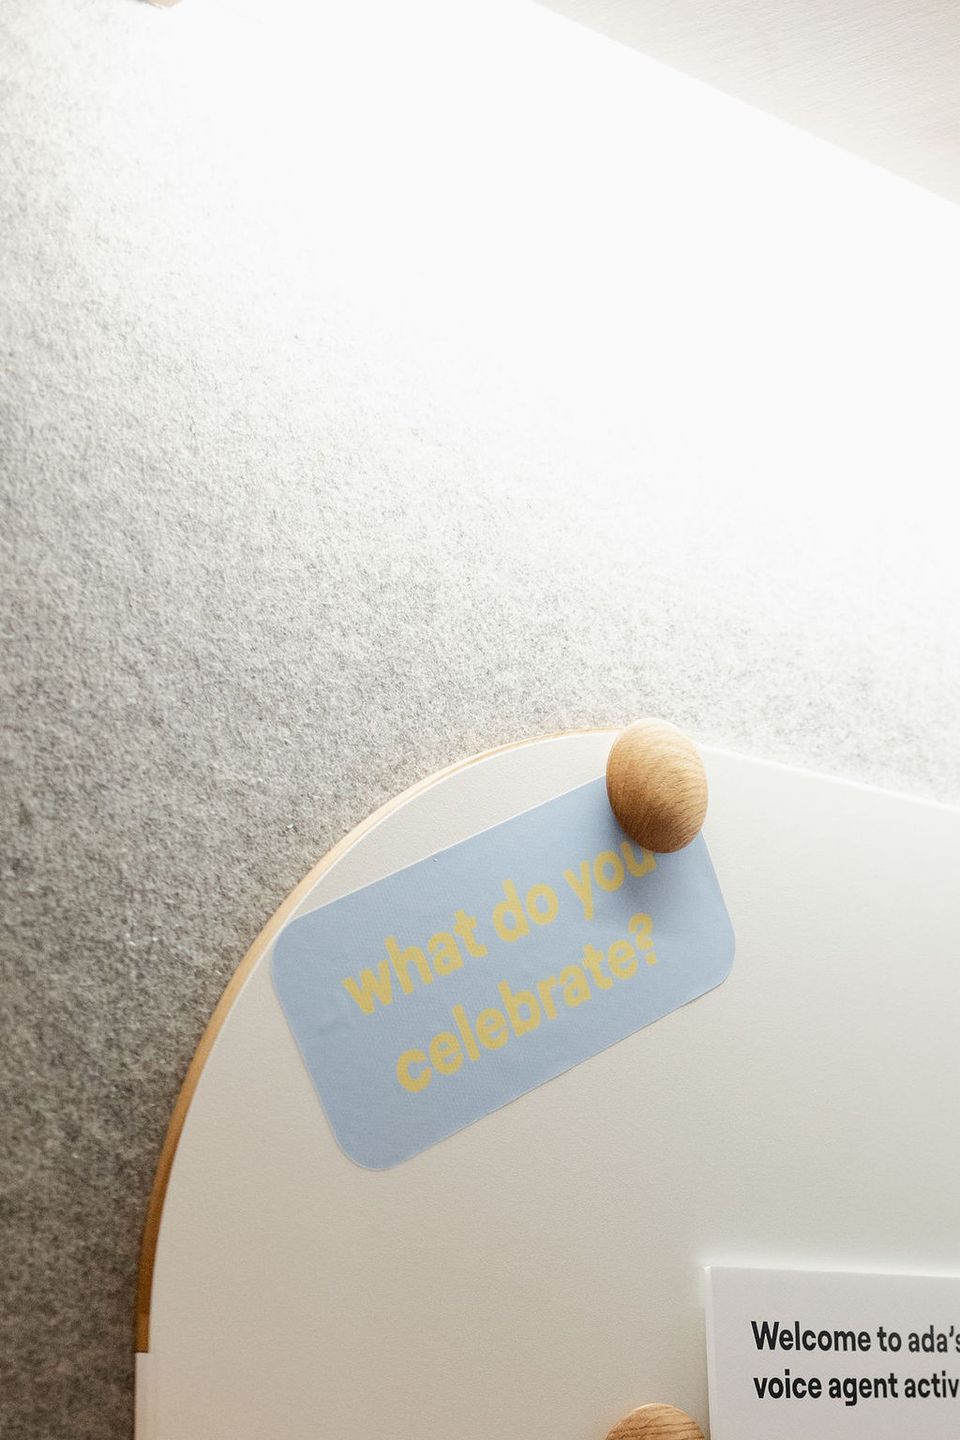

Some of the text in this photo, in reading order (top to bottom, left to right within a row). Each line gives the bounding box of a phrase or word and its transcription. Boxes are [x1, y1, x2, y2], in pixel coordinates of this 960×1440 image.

[342, 841, 657, 1016] what do you
[396, 912, 657, 1093] celebrate?
[751, 1320, 871, 1351] Welcome
[877, 1326, 902, 1352] to
[753, 1368, 822, 1399] voice
[828, 1373, 898, 1406] agent
